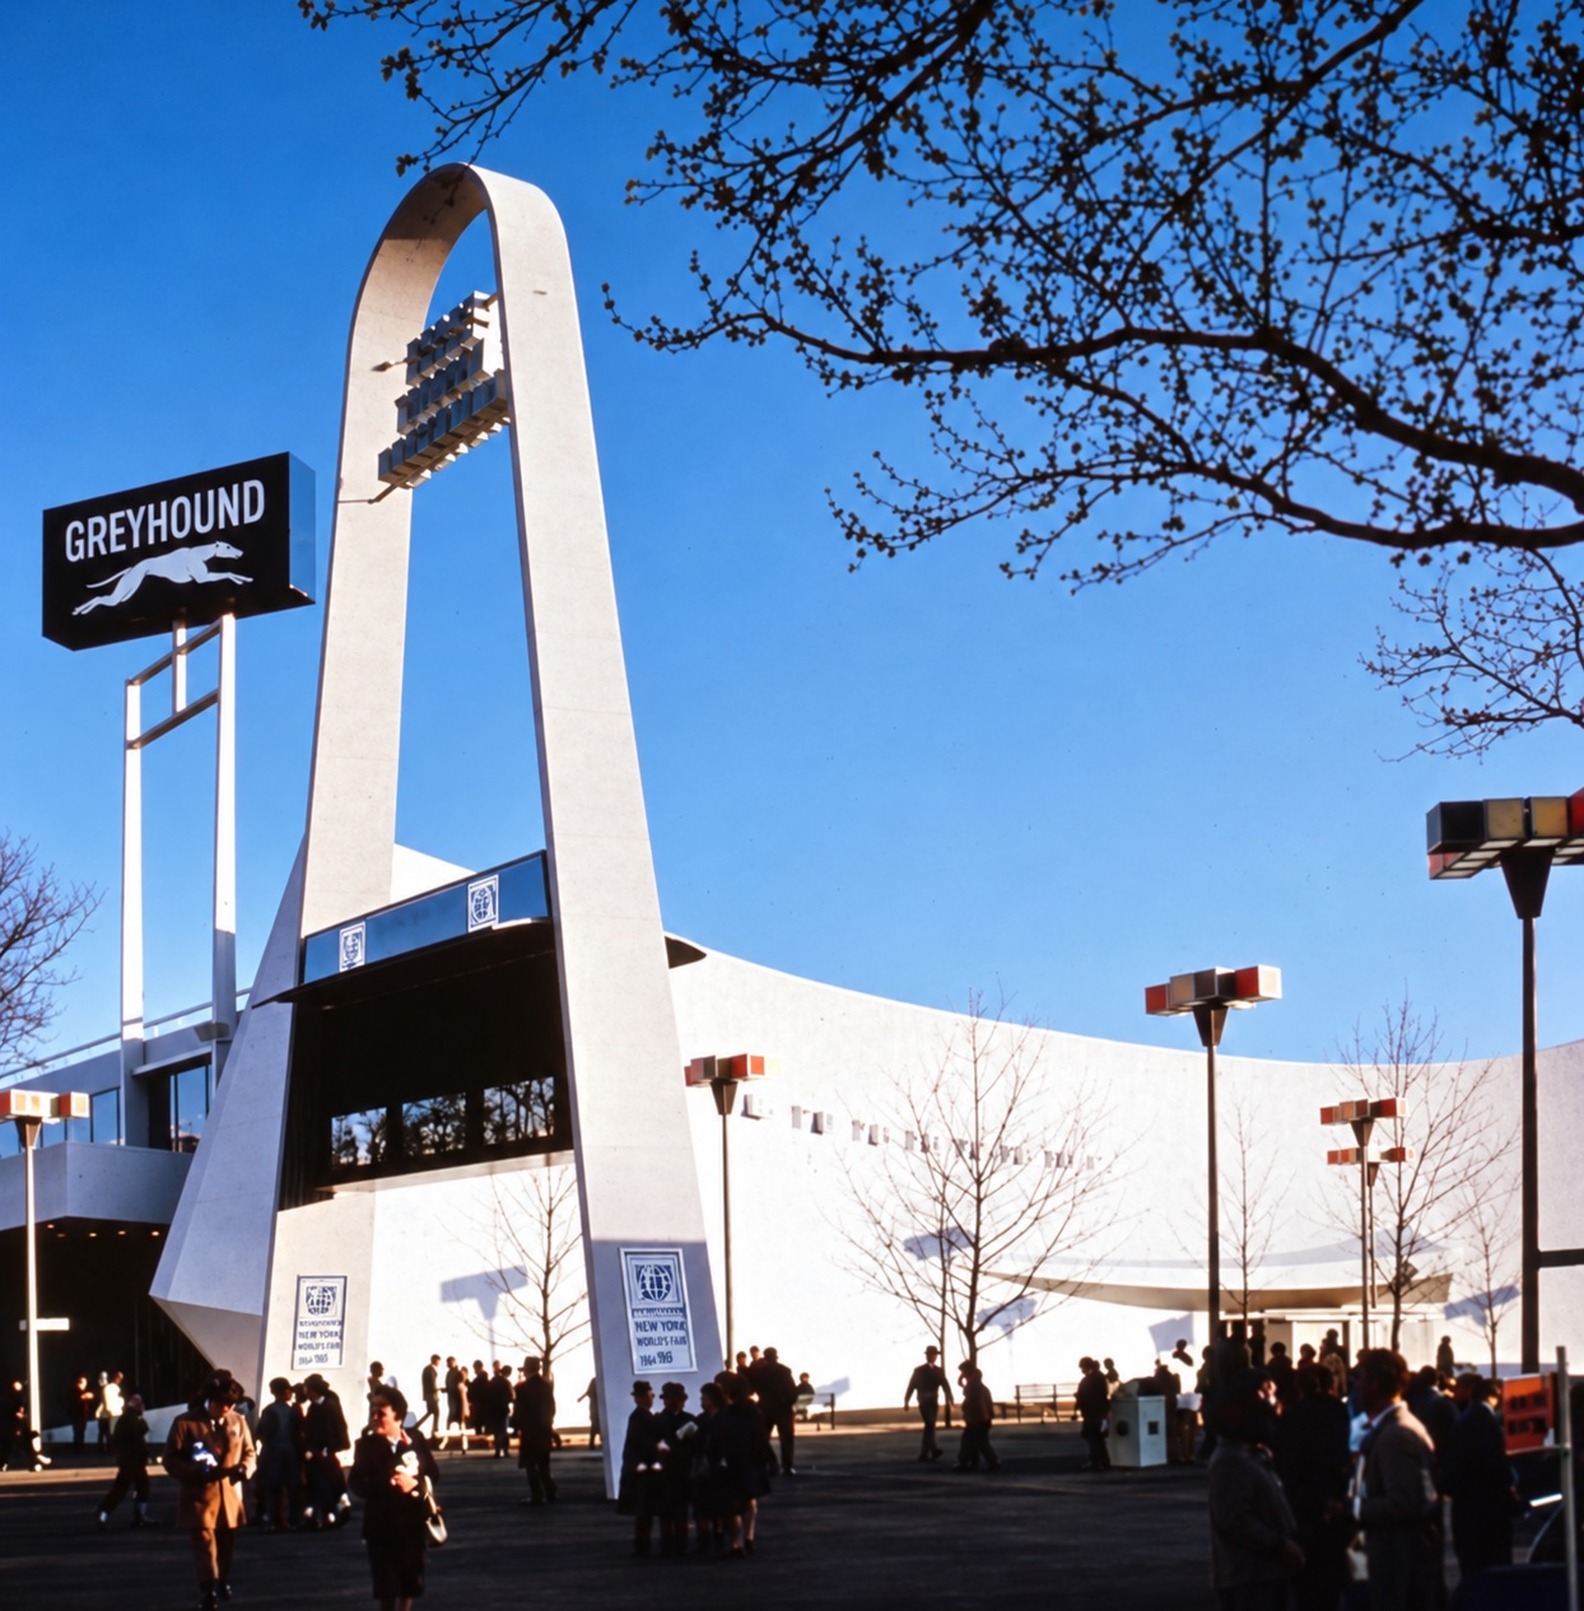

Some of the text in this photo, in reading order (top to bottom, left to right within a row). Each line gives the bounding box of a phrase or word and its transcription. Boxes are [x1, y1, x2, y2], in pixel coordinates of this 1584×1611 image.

[65, 479, 266, 563] GREYHOUND
[635, 1320, 686, 1332] NEW YORK
[636, 1336, 669, 1346] WORLD'S
